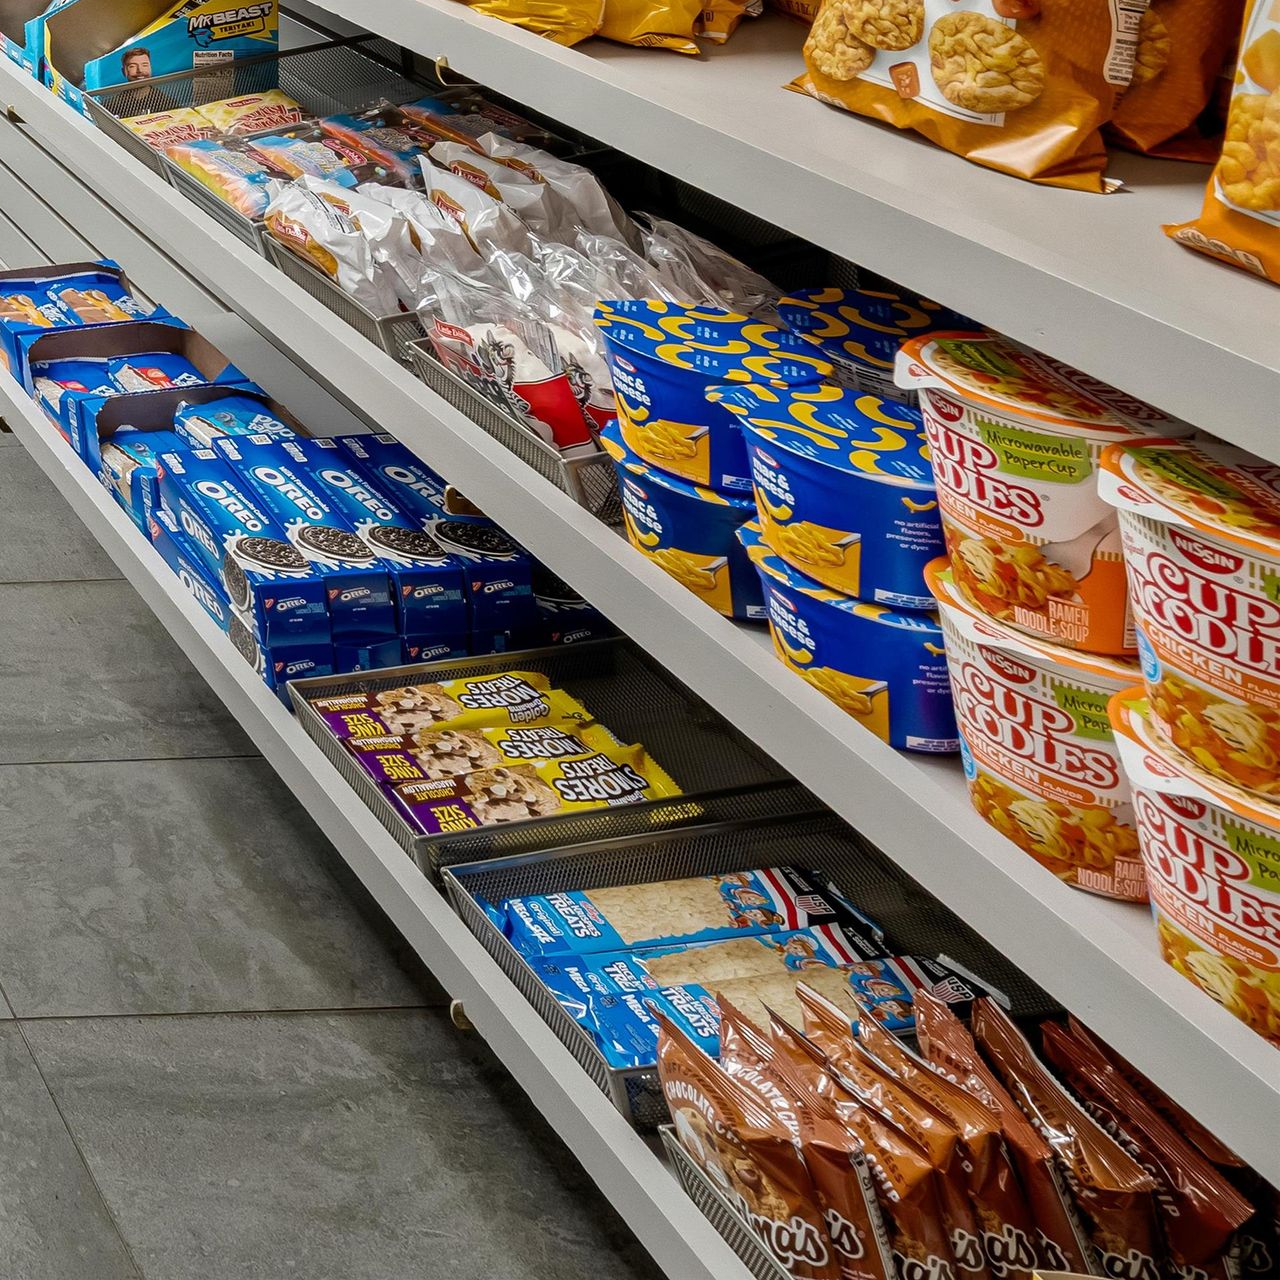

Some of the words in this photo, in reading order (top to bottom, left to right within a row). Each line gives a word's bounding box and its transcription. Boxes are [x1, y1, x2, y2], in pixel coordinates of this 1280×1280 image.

[218, 21, 255, 34] TERIYAKI
[194, 51, 218, 59] Nutrition
[613, 365, 634, 386] mac
[635, 378, 646, 393] &
[613, 374, 651, 406] cheese
[986, 430, 1083, 459] Microwavable
[753, 456, 776, 483] mac
[1003, 450, 1044, 470] Paper
[1044, 459, 1077, 476] Cup
[252, 465, 324, 520] OREO
[319, 468, 394, 521] OREO
[753, 470, 795, 505] cheese
[195, 479, 264, 532] OREO
[624, 485, 646, 512] mac
[647, 506, 658, 521] &
[624, 498, 662, 534] cheese
[905, 521, 940, 529] artificial
[1175, 537, 1235, 570] NISSIN
[178, 570, 225, 622] OREO
[770, 596, 794, 626] mac
[1014, 606, 1057, 634] NOODLE
[1058, 621, 1089, 642] SOUP
[1048, 601, 1089, 625] RAMEN
[770, 610, 815, 649] cheese
[980, 649, 1030, 681] NISSIN
[1148, 626, 1243, 683] CHICKEN
[468, 673, 524, 695] TREATS
[961, 661, 1075, 735] CUP
[343, 713, 377, 726] SIZE
[510, 705, 550, 724] Golden
[347, 723, 386, 737] KING
[378, 754, 412, 768] SIZE
[381, 765, 422, 780] KING
[561, 754, 618, 770] TREATS
[965, 729, 1040, 782] CHICKEN
[1043, 780, 1084, 802] FLAVOR
[402, 778, 457, 794] MARSHMALLOW
[433, 804, 466, 819] SIZE
[1077, 867, 1121, 894] NOODLE
[509, 898, 532, 925] MEGA
[528, 901, 564, 937] Original
[545, 893, 591, 939] TREATS
[571, 901, 601, 938] KRISPIES
[1218, 931, 1264, 959] FLAVOR
[565, 967, 590, 993] MEGA
[621, 994, 649, 1023] MEGA
[660, 989, 715, 1037] TREATS
[665, 1079, 716, 1127] CHOCOLATE
